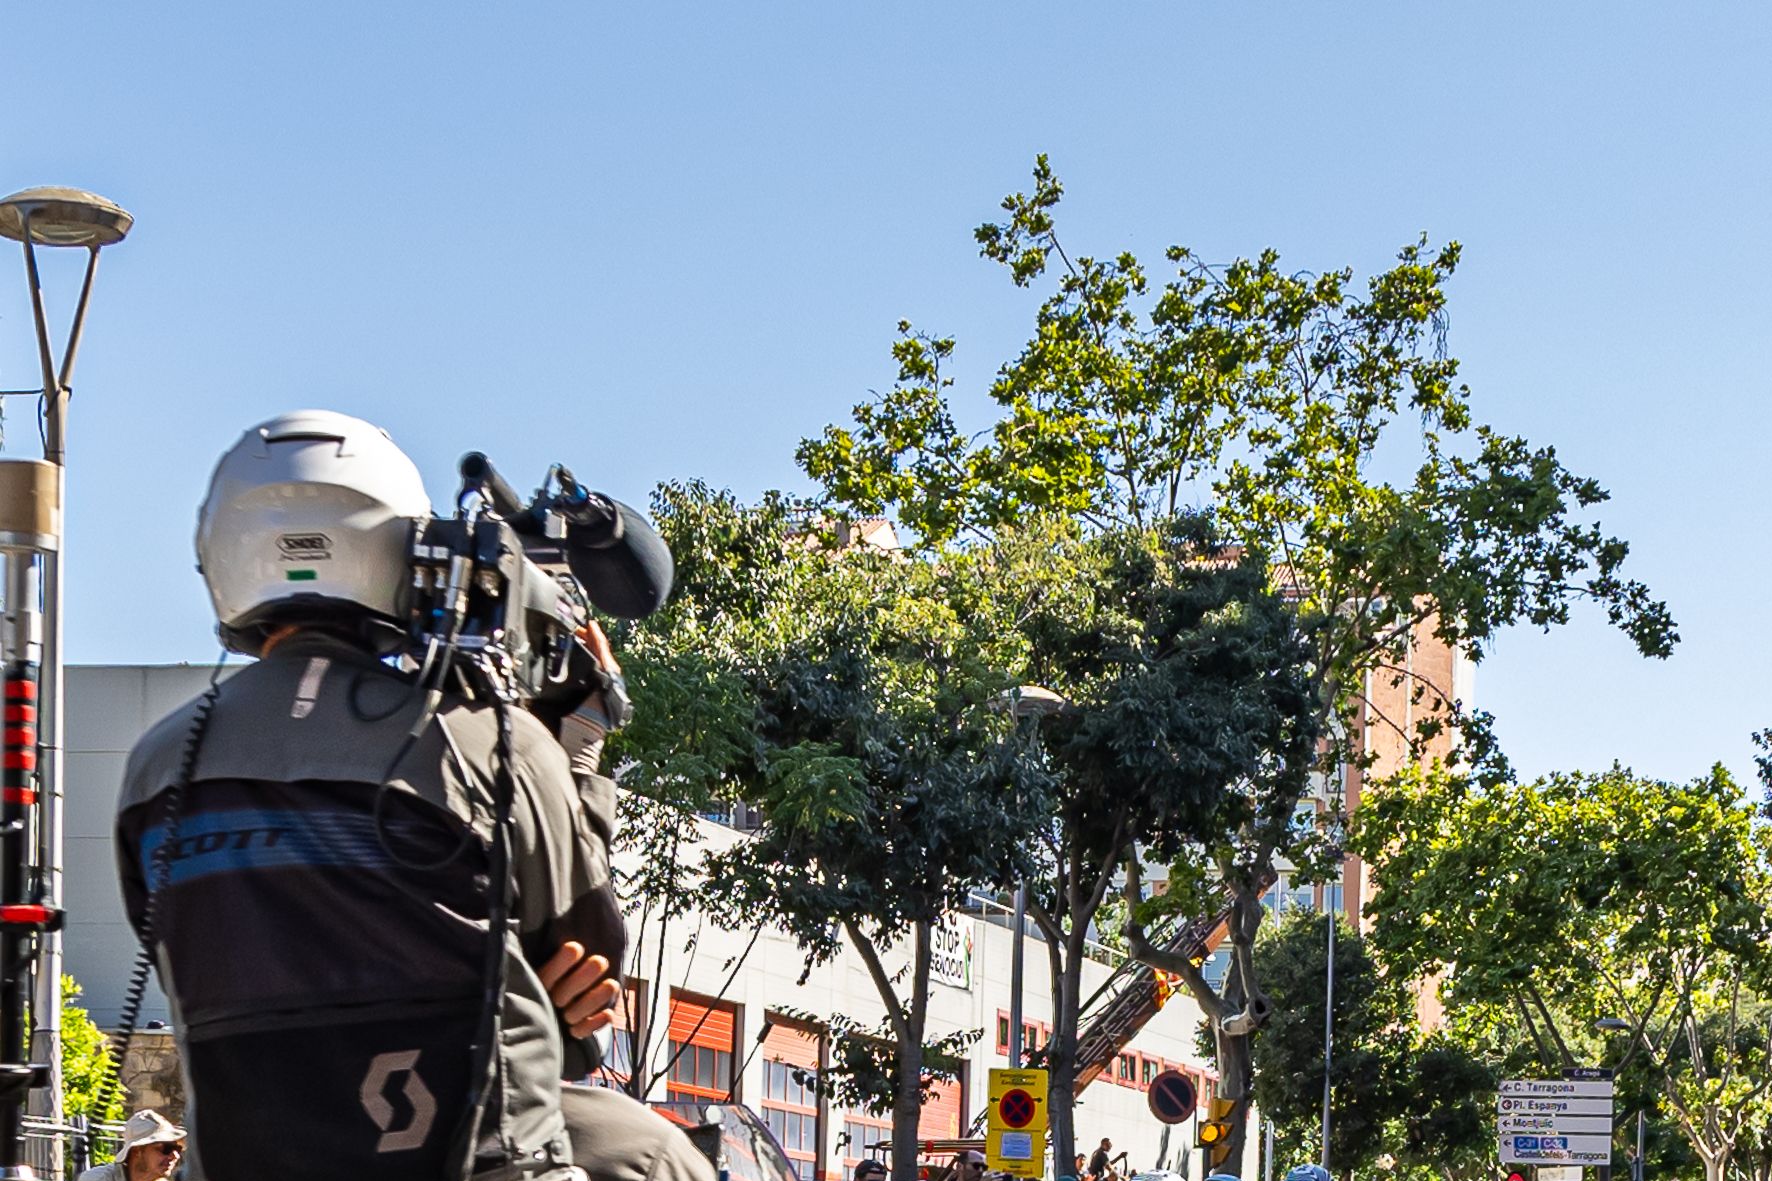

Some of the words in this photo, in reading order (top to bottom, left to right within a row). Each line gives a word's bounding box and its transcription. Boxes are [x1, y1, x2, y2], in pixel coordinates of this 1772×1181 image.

[154, 828, 295, 862] COTT
[935, 926, 960, 955] STOP
[1513, 1083, 1525, 1092] C.
[1527, 1083, 1575, 1094] Tarragona
[1528, 1100, 1568, 1112] Espanya
